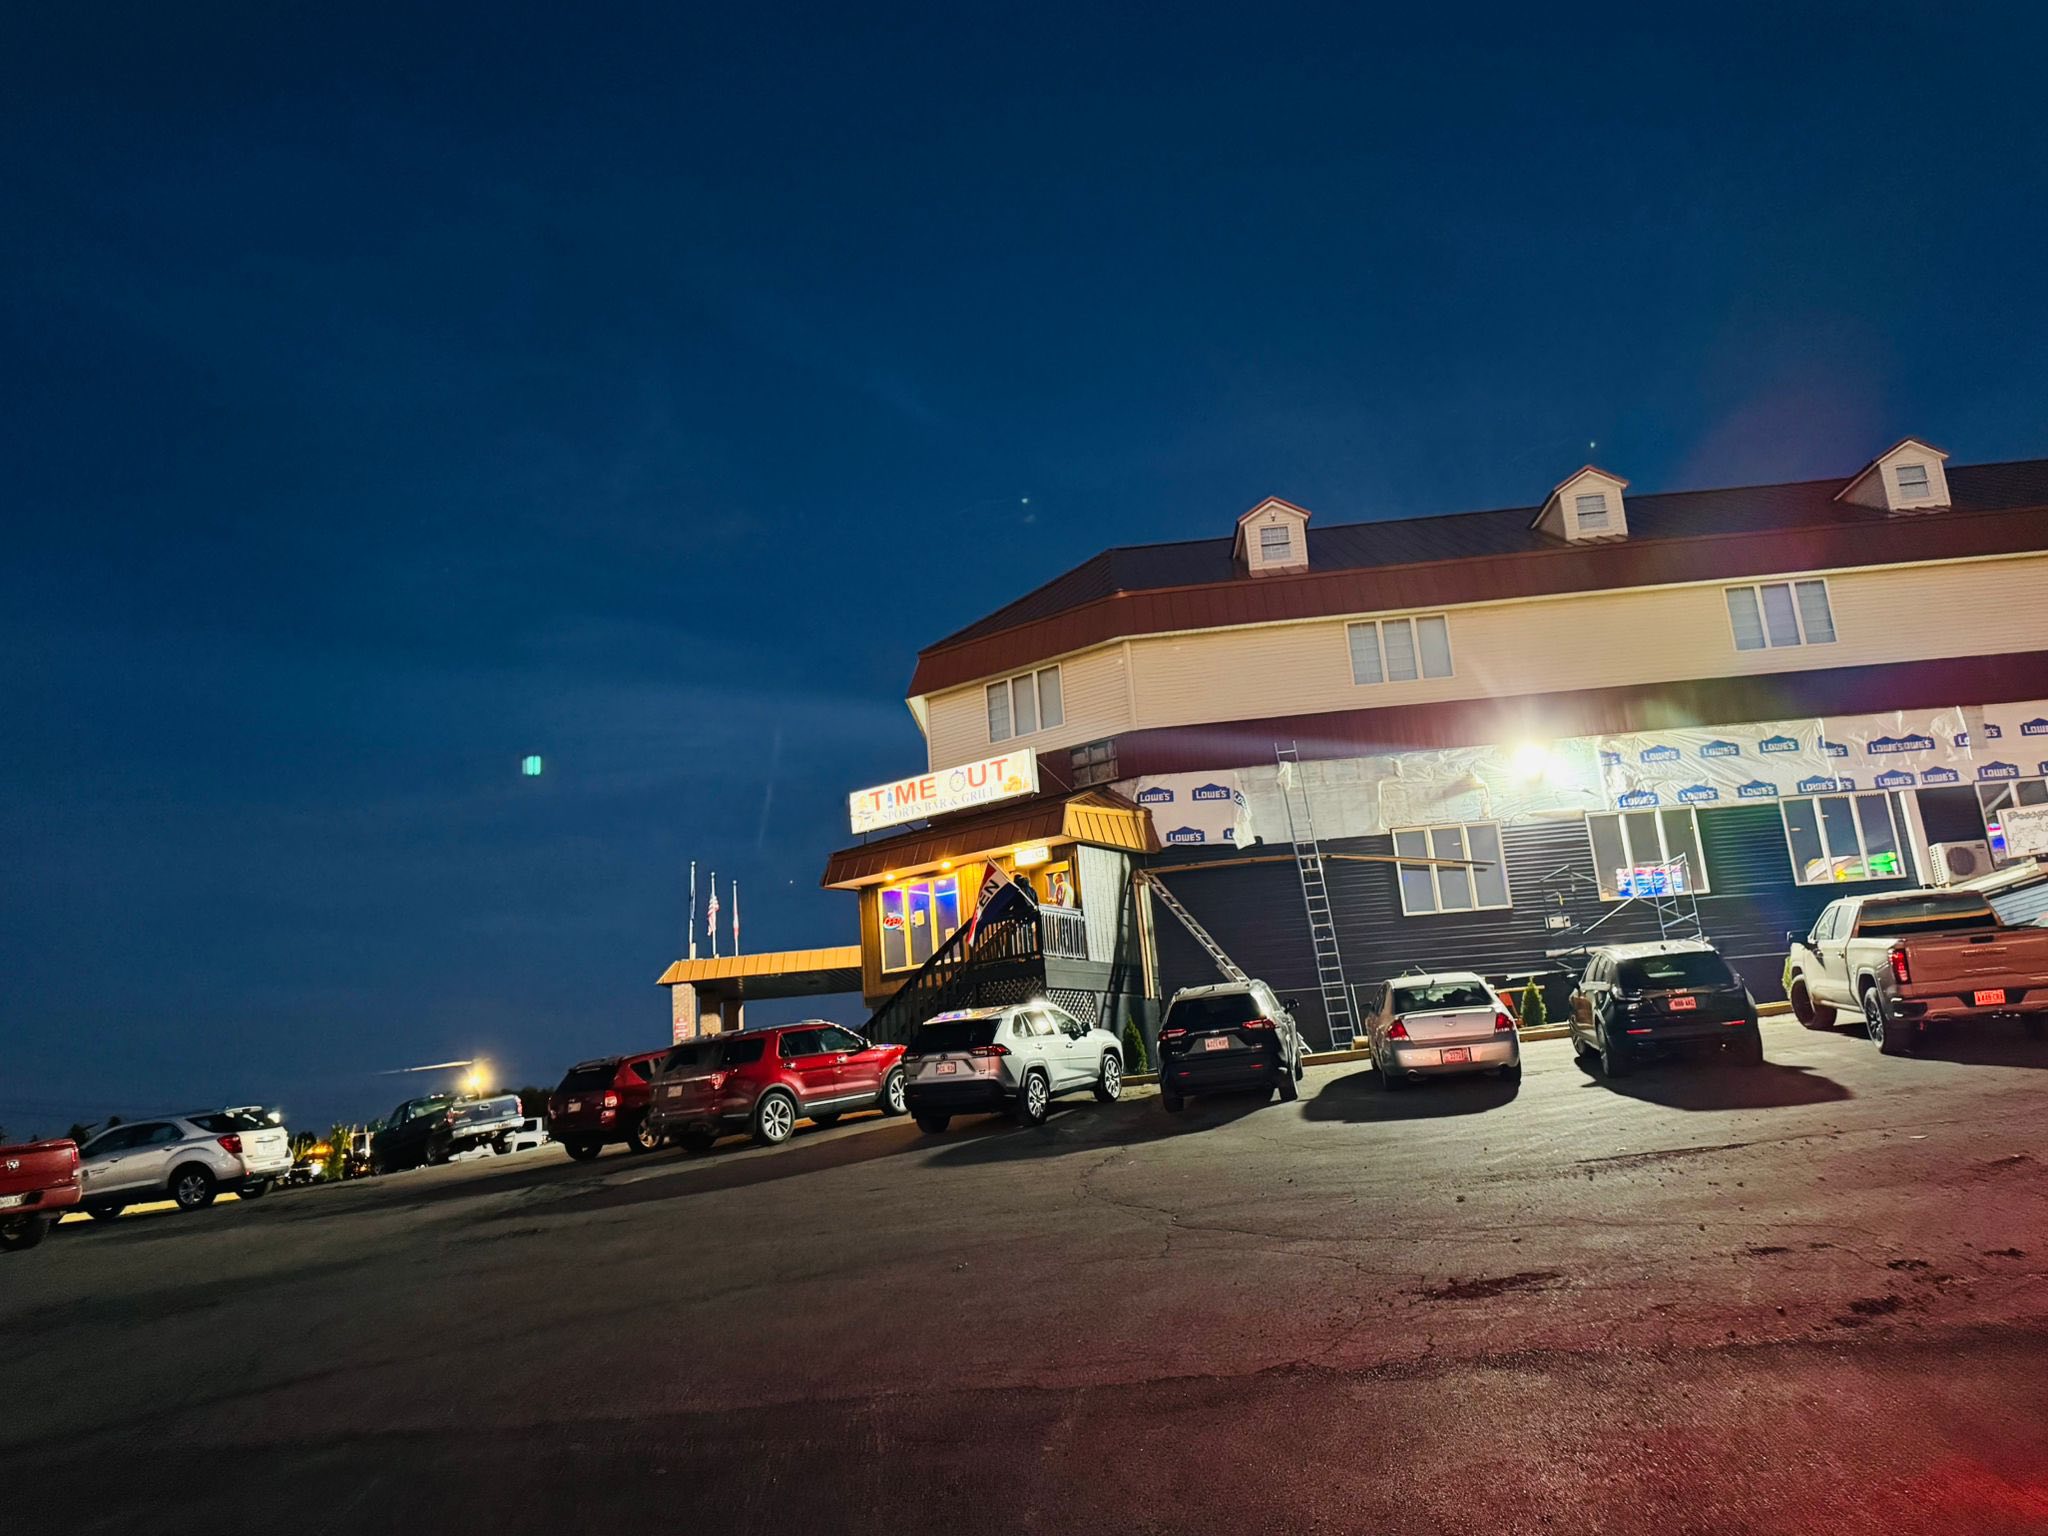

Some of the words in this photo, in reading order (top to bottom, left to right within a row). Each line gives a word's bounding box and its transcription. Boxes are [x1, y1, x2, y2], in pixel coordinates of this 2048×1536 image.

[1703, 745, 1737, 757] LOWE'S
[1762, 741, 1795, 752] LOWE'S
[1870, 742, 1903, 753] LOWE'S
[1643, 750, 1676, 762] LOWE'S
[1922, 771, 1956, 783] LOWE'S
[1982, 766, 2016, 777] LOWE'S
[1878, 775, 1912, 786] LOWE'S
[1800, 781, 1834, 792] LOWE'S
[868, 776, 937, 811] TIME
[1140, 791, 1171, 802] LOWE'S
[1195, 788, 1228, 799] LOWE'S
[925, 798, 944, 812] BAR
[945, 798, 957, 807] &
[1170, 831, 1202, 842] LOWE'S
